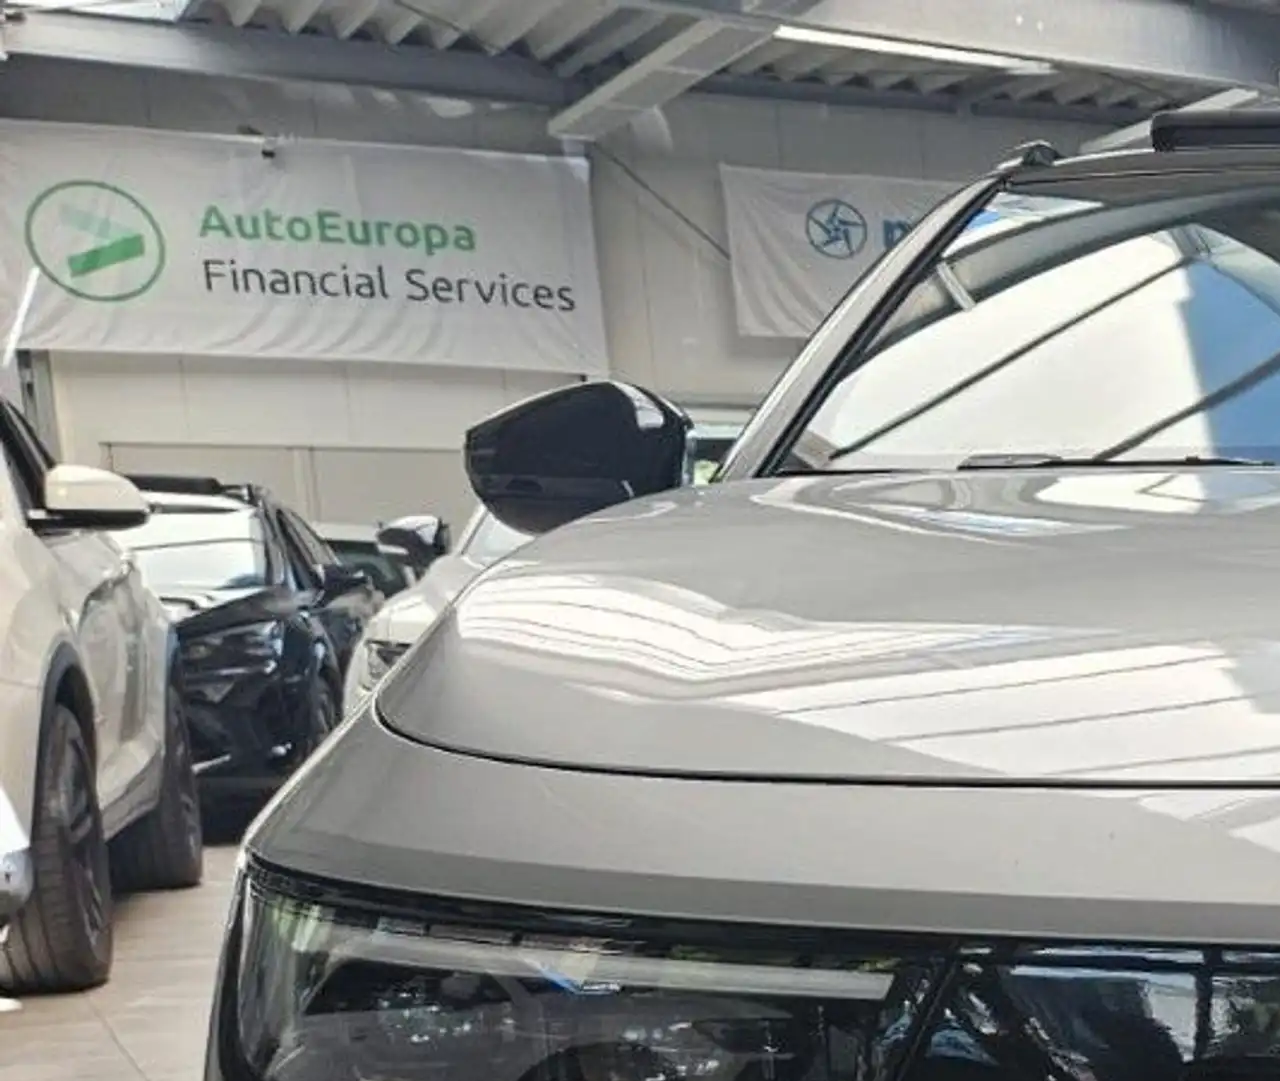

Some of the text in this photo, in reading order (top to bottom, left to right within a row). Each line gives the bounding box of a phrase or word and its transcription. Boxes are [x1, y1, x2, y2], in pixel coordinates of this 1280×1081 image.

[199, 205, 476, 256] AutoEuropa
[203, 259, 576, 312] Financial Services
